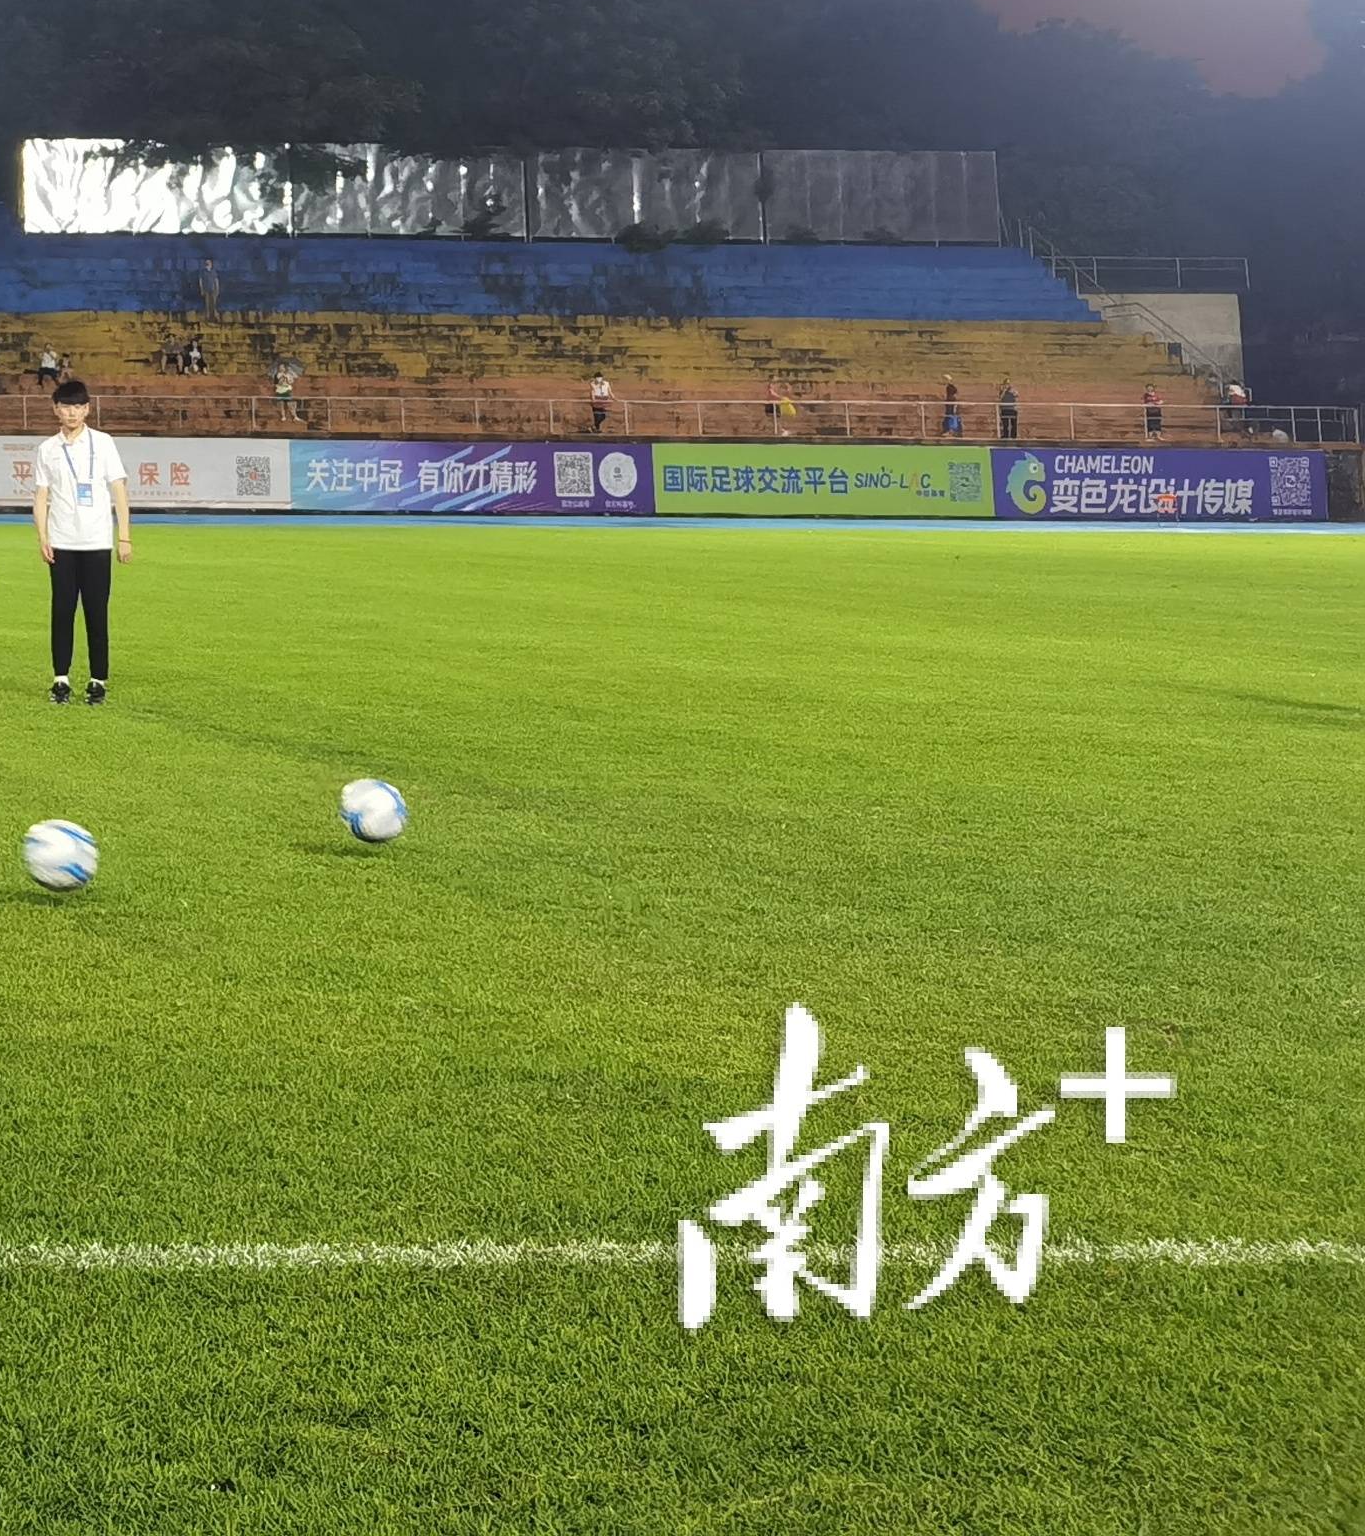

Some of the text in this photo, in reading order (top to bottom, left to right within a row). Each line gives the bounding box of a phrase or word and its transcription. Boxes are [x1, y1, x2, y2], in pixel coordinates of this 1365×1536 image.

[306, 459, 537, 494] 关注中冠 有你才精彩
[663, 465, 849, 494] 国际足球交流平台
[1054, 455, 1154, 474] CHAMELEON
[1050, 477, 1254, 515] 变色龙设计传媒
